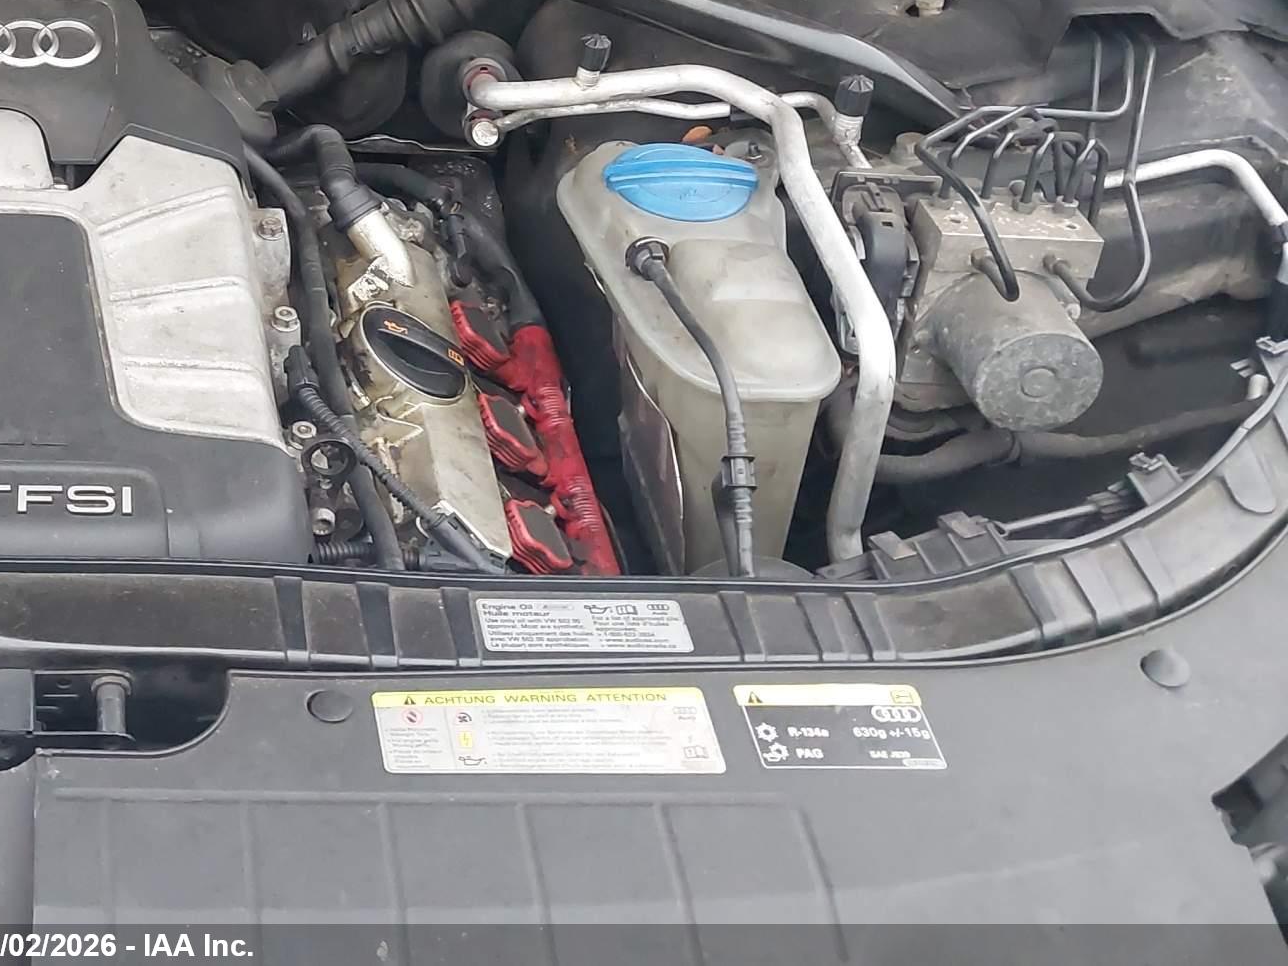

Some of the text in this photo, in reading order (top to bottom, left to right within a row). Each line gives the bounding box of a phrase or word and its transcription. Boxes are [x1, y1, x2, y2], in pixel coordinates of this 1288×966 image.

[481, 603, 516, 611] Engine
[424, 692, 668, 705] ACHTUNG WARNING ATTENTION
[787, 727, 830, 738] R-134a
[852, 726, 887, 740] 630g
[795, 748, 824, 759] PAG
